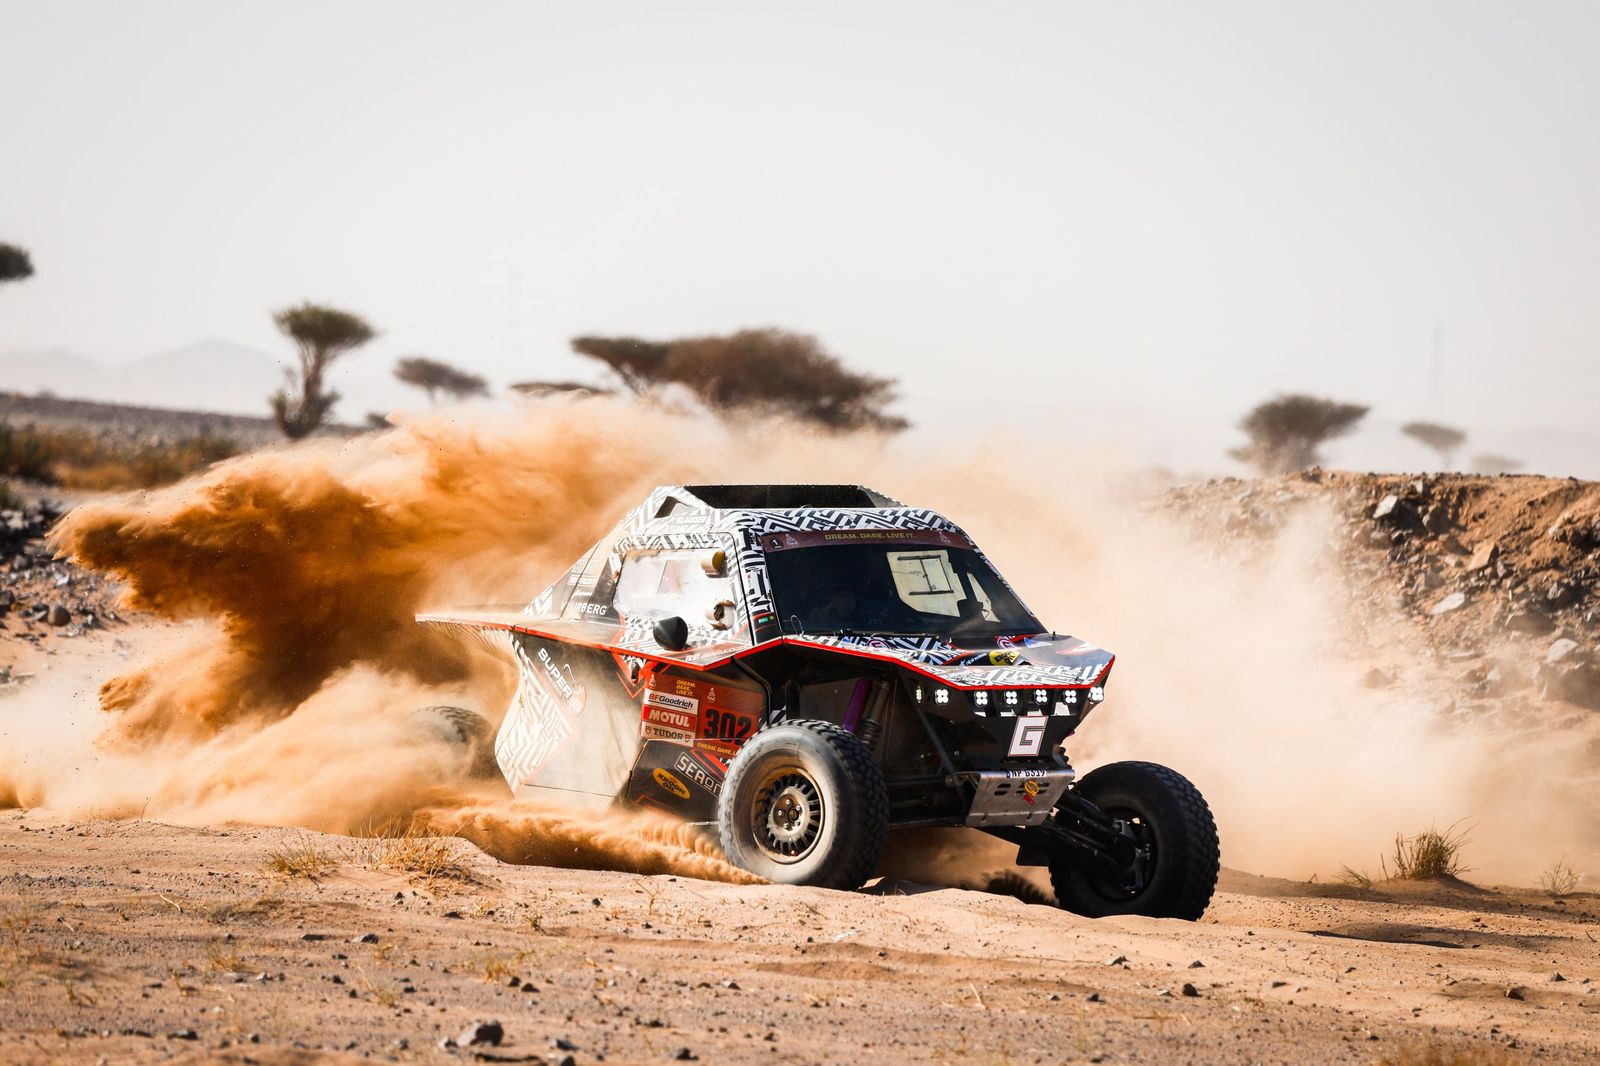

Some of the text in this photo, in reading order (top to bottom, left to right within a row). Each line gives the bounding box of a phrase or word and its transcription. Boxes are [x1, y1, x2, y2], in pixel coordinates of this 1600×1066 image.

[538, 648, 573, 699] SUPER
[649, 710, 690, 728] MOTUL
[653, 727, 683, 740] TUDOR
[704, 709, 752, 746] 302
[1008, 715, 1049, 757] G
